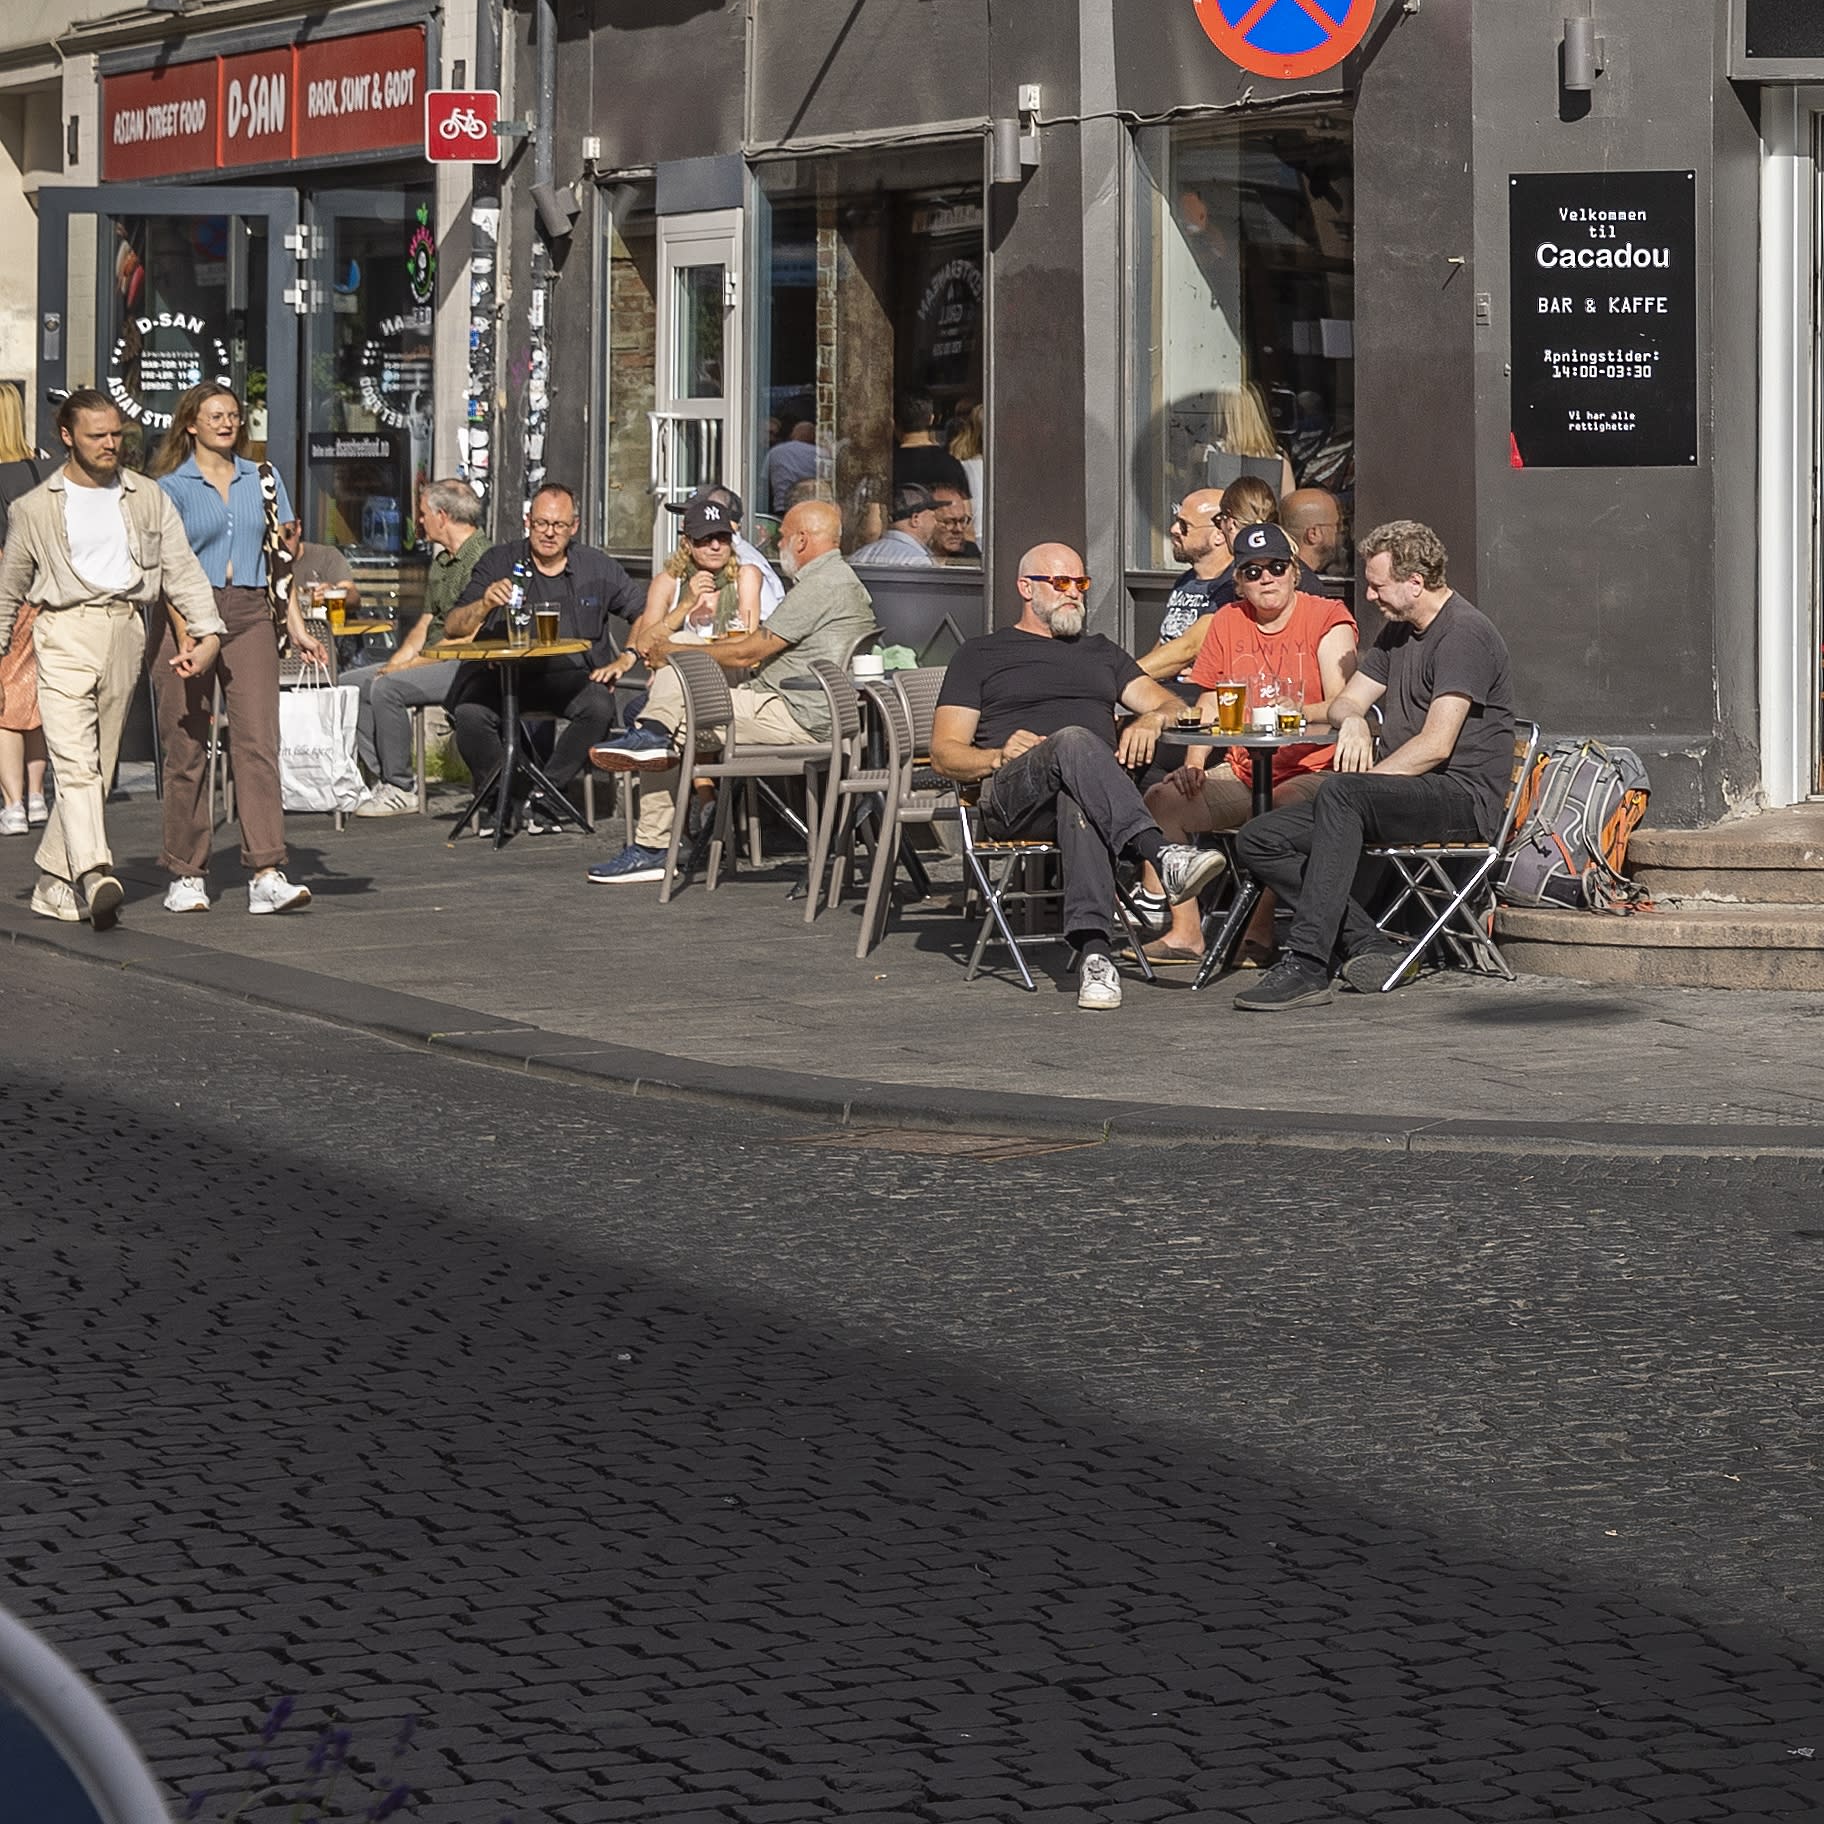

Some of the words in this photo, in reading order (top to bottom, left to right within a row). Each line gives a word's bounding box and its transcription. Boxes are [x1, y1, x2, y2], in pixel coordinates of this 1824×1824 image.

[340, 73, 372, 114] SUNT
[371, 71, 383, 109] &
[384, 67, 416, 107] GODT
[113, 109, 144, 144] ASIAN
[145, 103, 178, 141] STREET
[179, 98, 207, 134] FOOD
[1559, 207, 1647, 221] Velkommen
[1589, 225, 1616, 238] til
[1536, 242, 1670, 268] Cacadou
[1537, 297, 1573, 313] BAR
[1585, 297, 1596, 313] &
[1608, 297, 1668, 313] KAFFE
[1543, 349, 1659, 363] Åpningstider:
[1552, 365, 1651, 378] 14:00-03:30
[106, 377, 143, 419] ASIAN
[1568, 411, 1581, 421] Vi
[1586, 411, 1605, 421] har
[1611, 411, 1636, 421] alle
[1568, 422, 1636, 432] rettigheter
[1248, 531, 1266, 548] G
[1235, 639, 1305, 656] SUNNY
